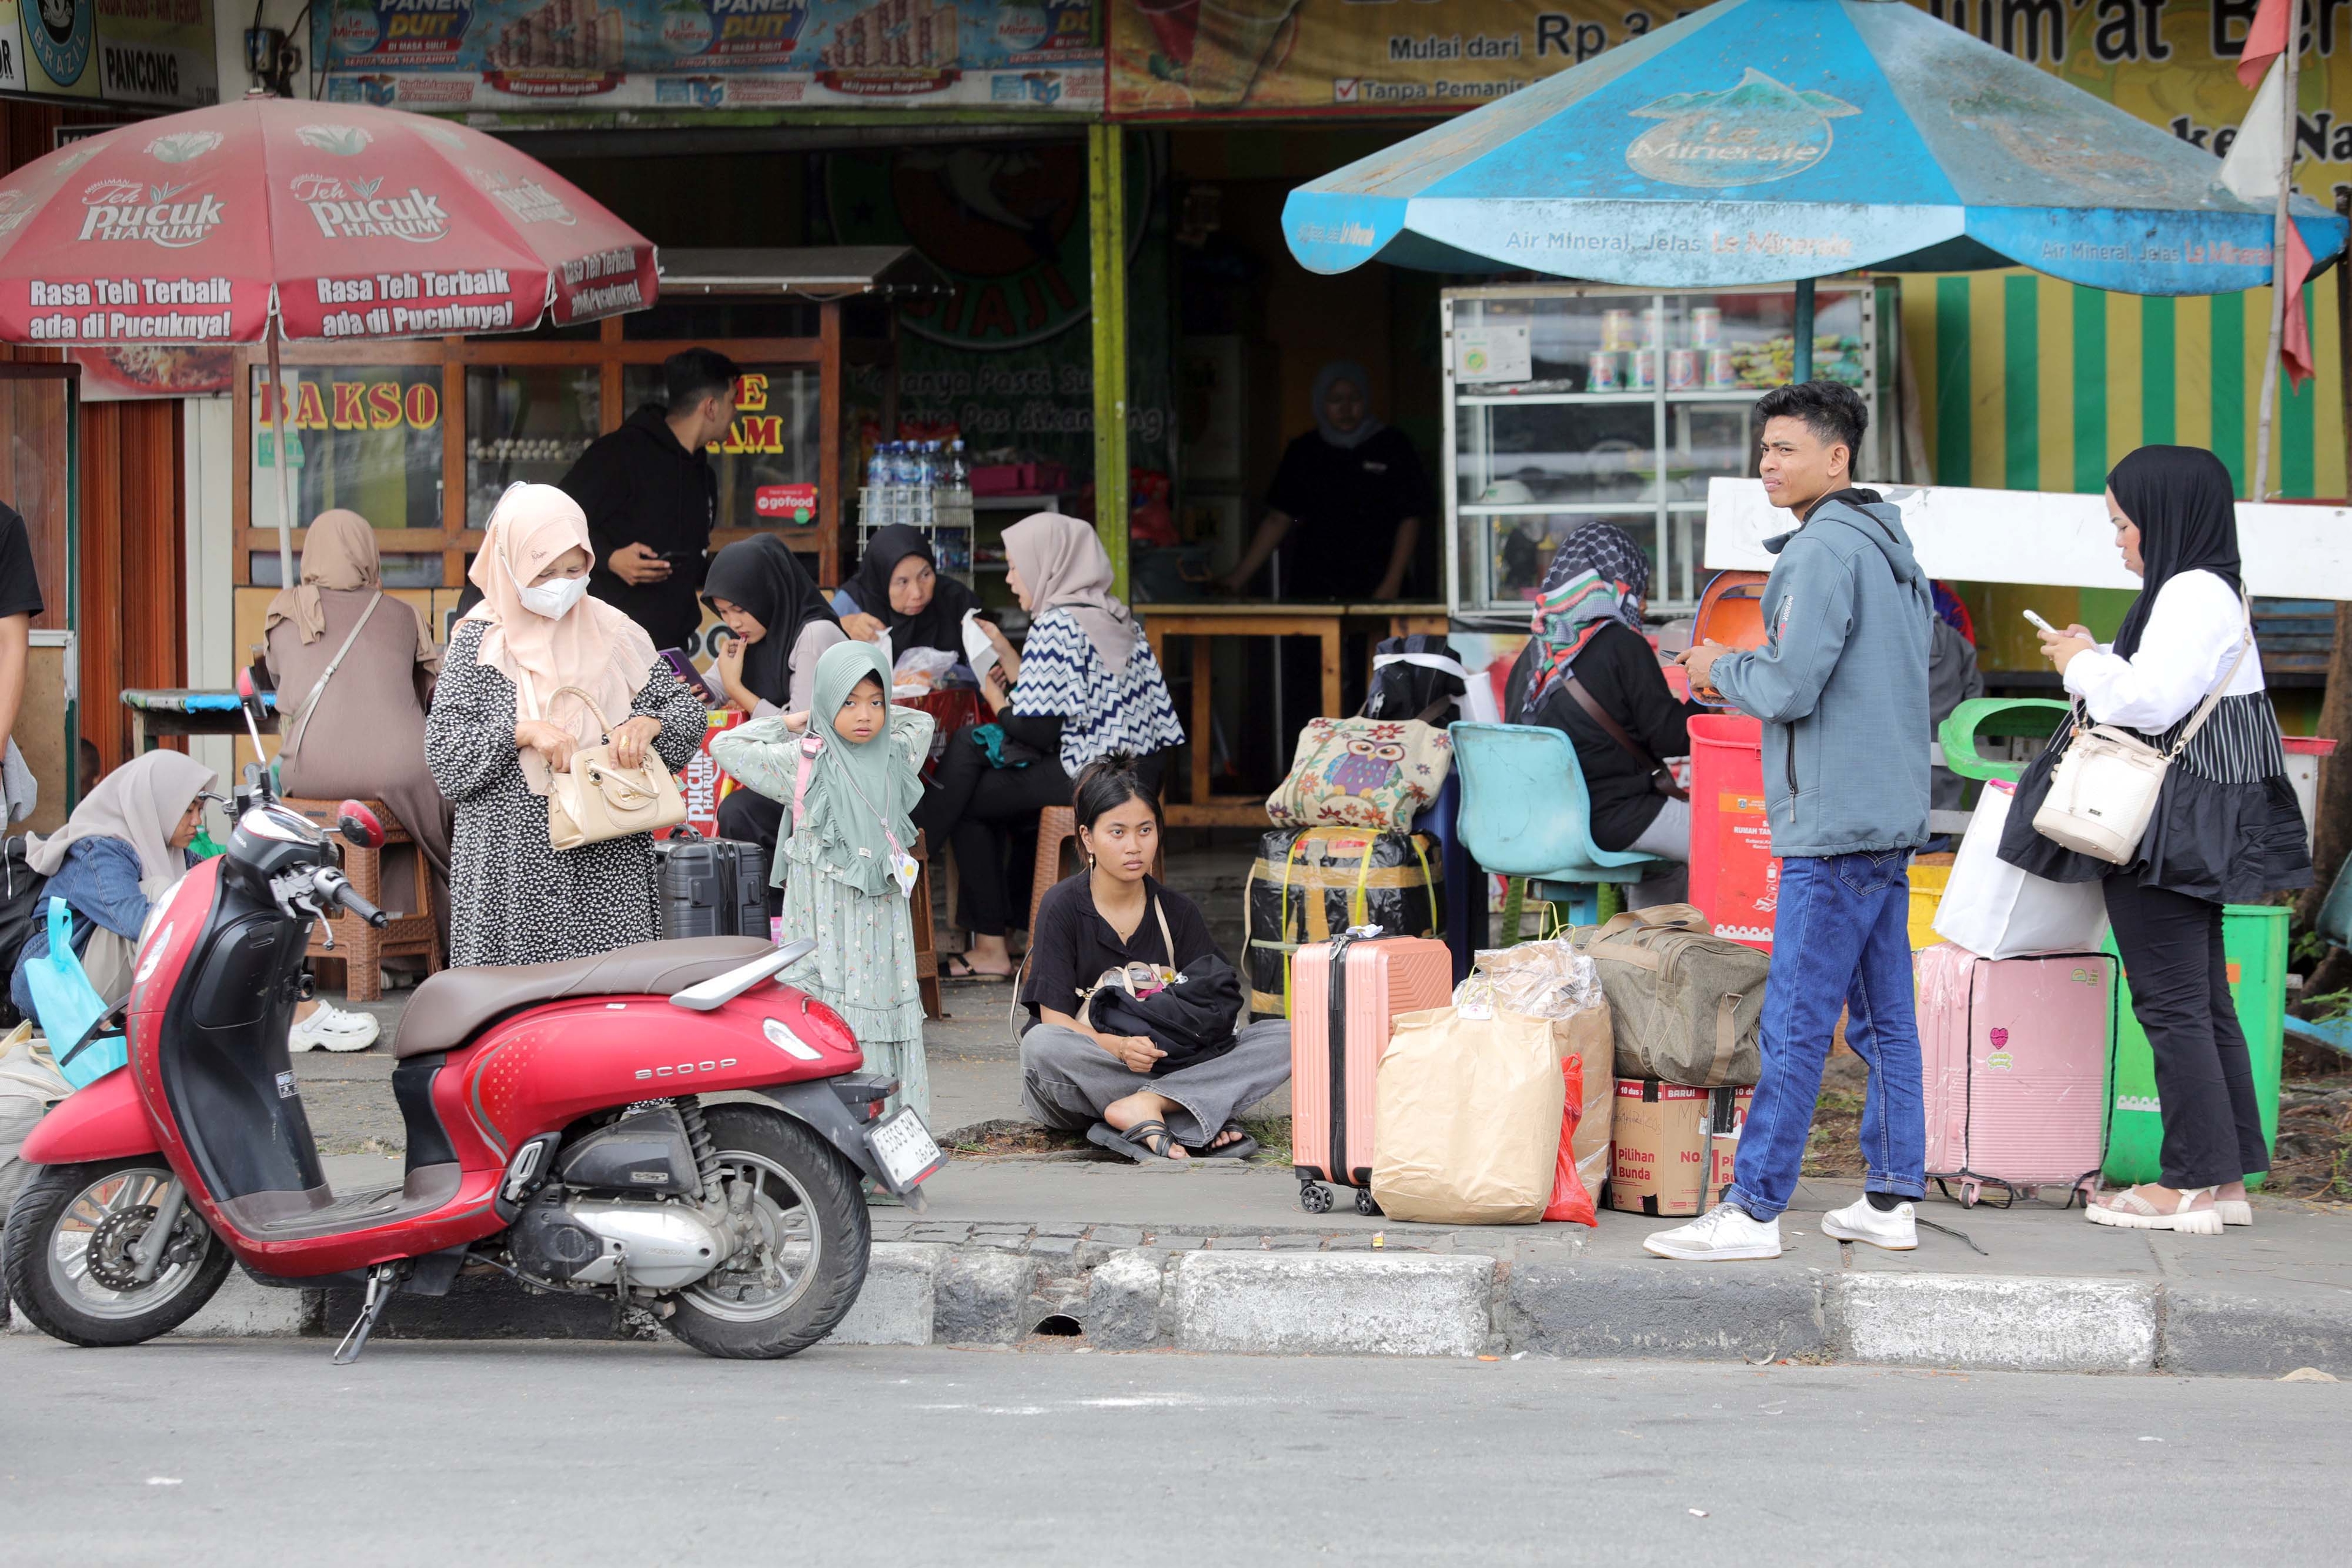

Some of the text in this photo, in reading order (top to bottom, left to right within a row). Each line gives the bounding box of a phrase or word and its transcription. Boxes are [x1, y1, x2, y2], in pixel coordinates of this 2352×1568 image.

[333, 27, 378, 39] Minerale
[349, 17, 362, 28] Le
[388, 13, 458, 38] DUIT
[722, 13, 792, 39] DUIT
[388, 40, 447, 51] DI MASA SULIT
[1390, 36, 1459, 59] Mulai
[1467, 35, 1520, 58] dari
[1537, 14, 1605, 64] Rp
[34, 26, 85, 77] BRAZIL
[105, 46, 179, 96] PANCONG
[510, 81, 598, 94] Milyaran Rupiah
[1363, 81, 1428, 103] Tanpa
[1627, 140, 1820, 162] Minerale
[80, 183, 143, 205] Teh
[293, 178, 347, 202] Teh
[76, 192, 227, 241] pucuk
[307, 186, 451, 238] pucuk
[101, 224, 207, 243] HARUM
[341, 217, 445, 239] HARUM
[1505, 228, 1854, 257] Air Mineral, Jelas Le Minerale
[2041, 239, 2065, 260] Air
[2071, 240, 2136, 262] Mineral,
[2139, 243, 2179, 262] Jelas
[2184, 240, 2204, 263] Le
[582, 254, 601, 280] Teh
[600, 245, 636, 276] Terbaik
[30, 277, 232, 306] Rasa Teh Terbaik
[317, 268, 510, 304] Rasa Teh Terbaik
[30, 310, 232, 340] ada di Pucuknya!
[322, 301, 513, 337] ada di Pucuknya!
[259, 381, 439, 431] BAKSO
[769, 495, 814, 511] gofood
[1782, 595, 1794, 622] OUTDOOR
[703, 755, 716, 810] HARUM
[1733, 826, 1757, 835] RUMAH
[635, 1058, 737, 1080] SCOOP
[1620, 1086, 1628, 1095] 10
[1628, 1087, 1639, 1096] dus
[1667, 1088, 1695, 1098] BARU!
[1618, 1148, 1655, 1163] Pilihan
[1618, 1166, 1651, 1180] Bunda
